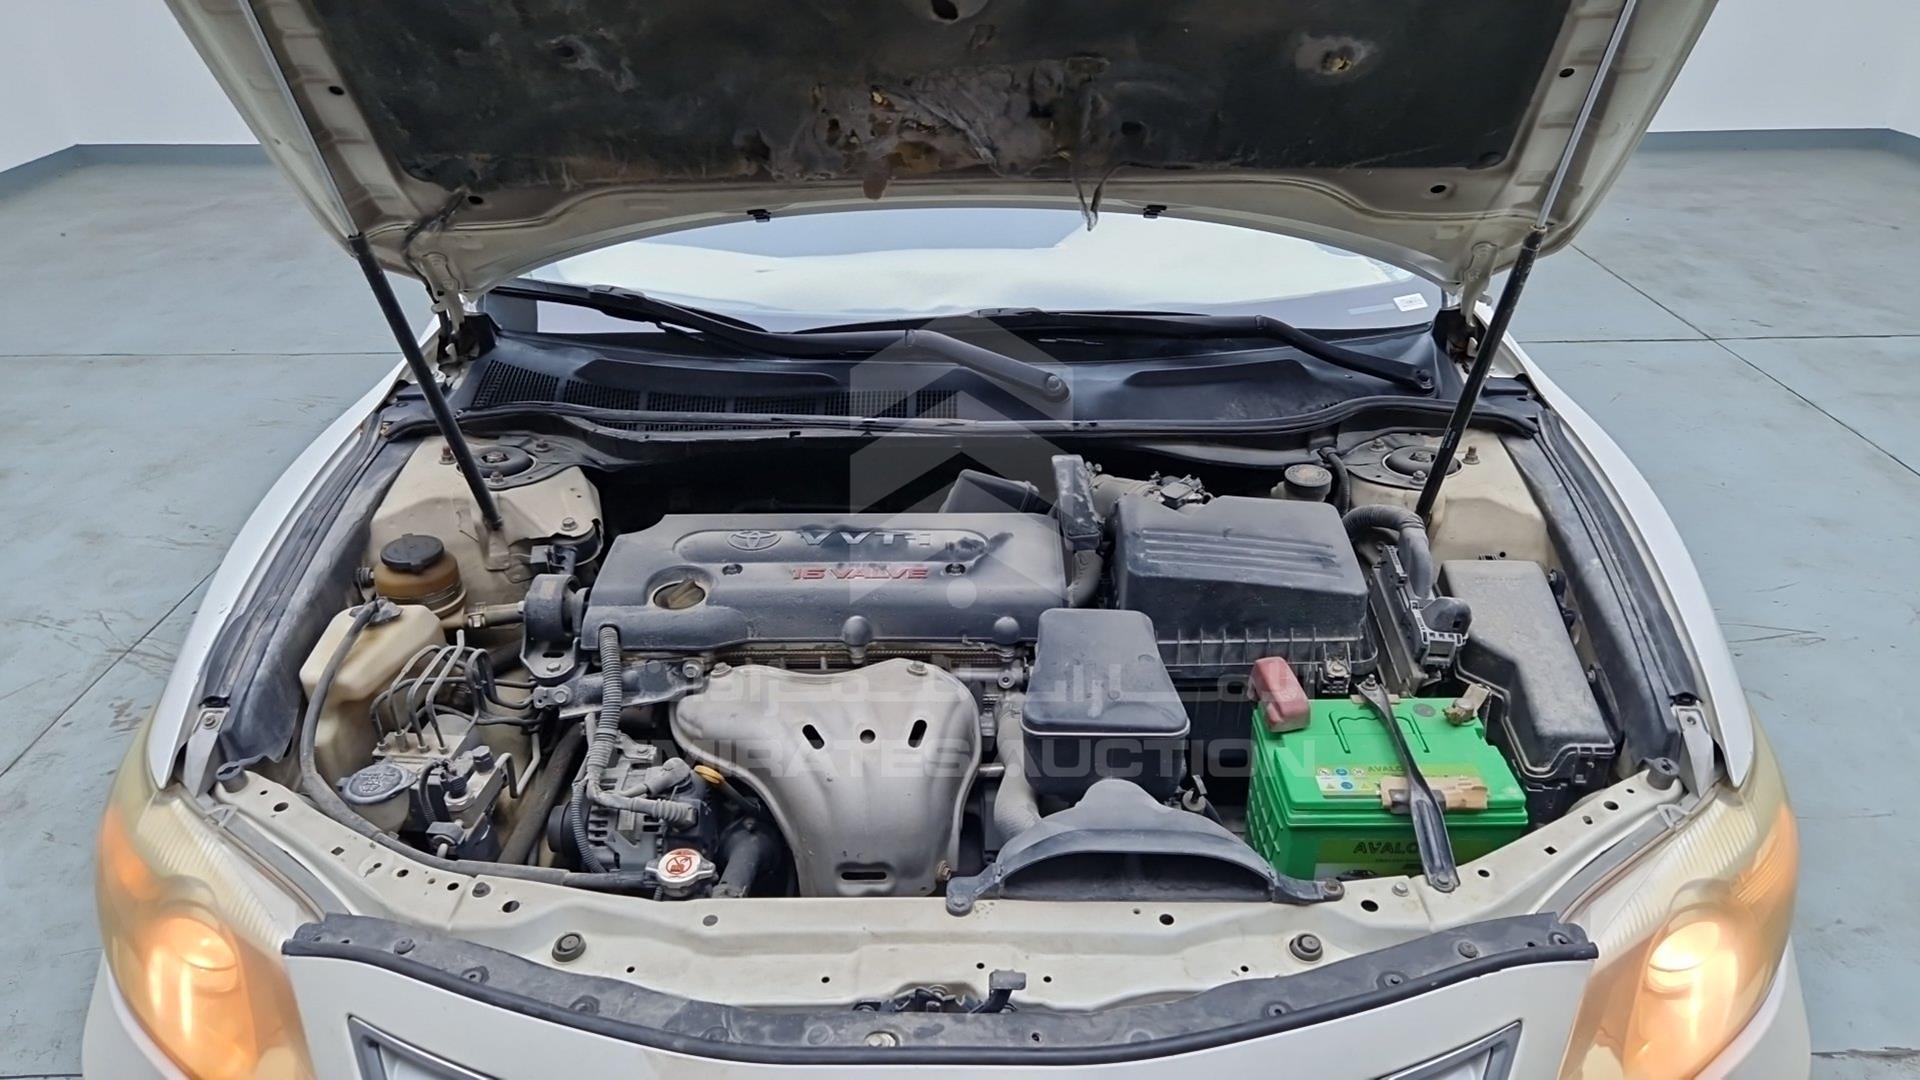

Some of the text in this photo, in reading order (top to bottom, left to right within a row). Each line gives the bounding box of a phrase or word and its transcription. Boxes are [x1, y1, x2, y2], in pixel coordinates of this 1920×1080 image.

[793, 567, 929, 580] 16 VALVE
[1367, 765, 1404, 773] AVALO
[1353, 841, 1418, 854] AVALO
